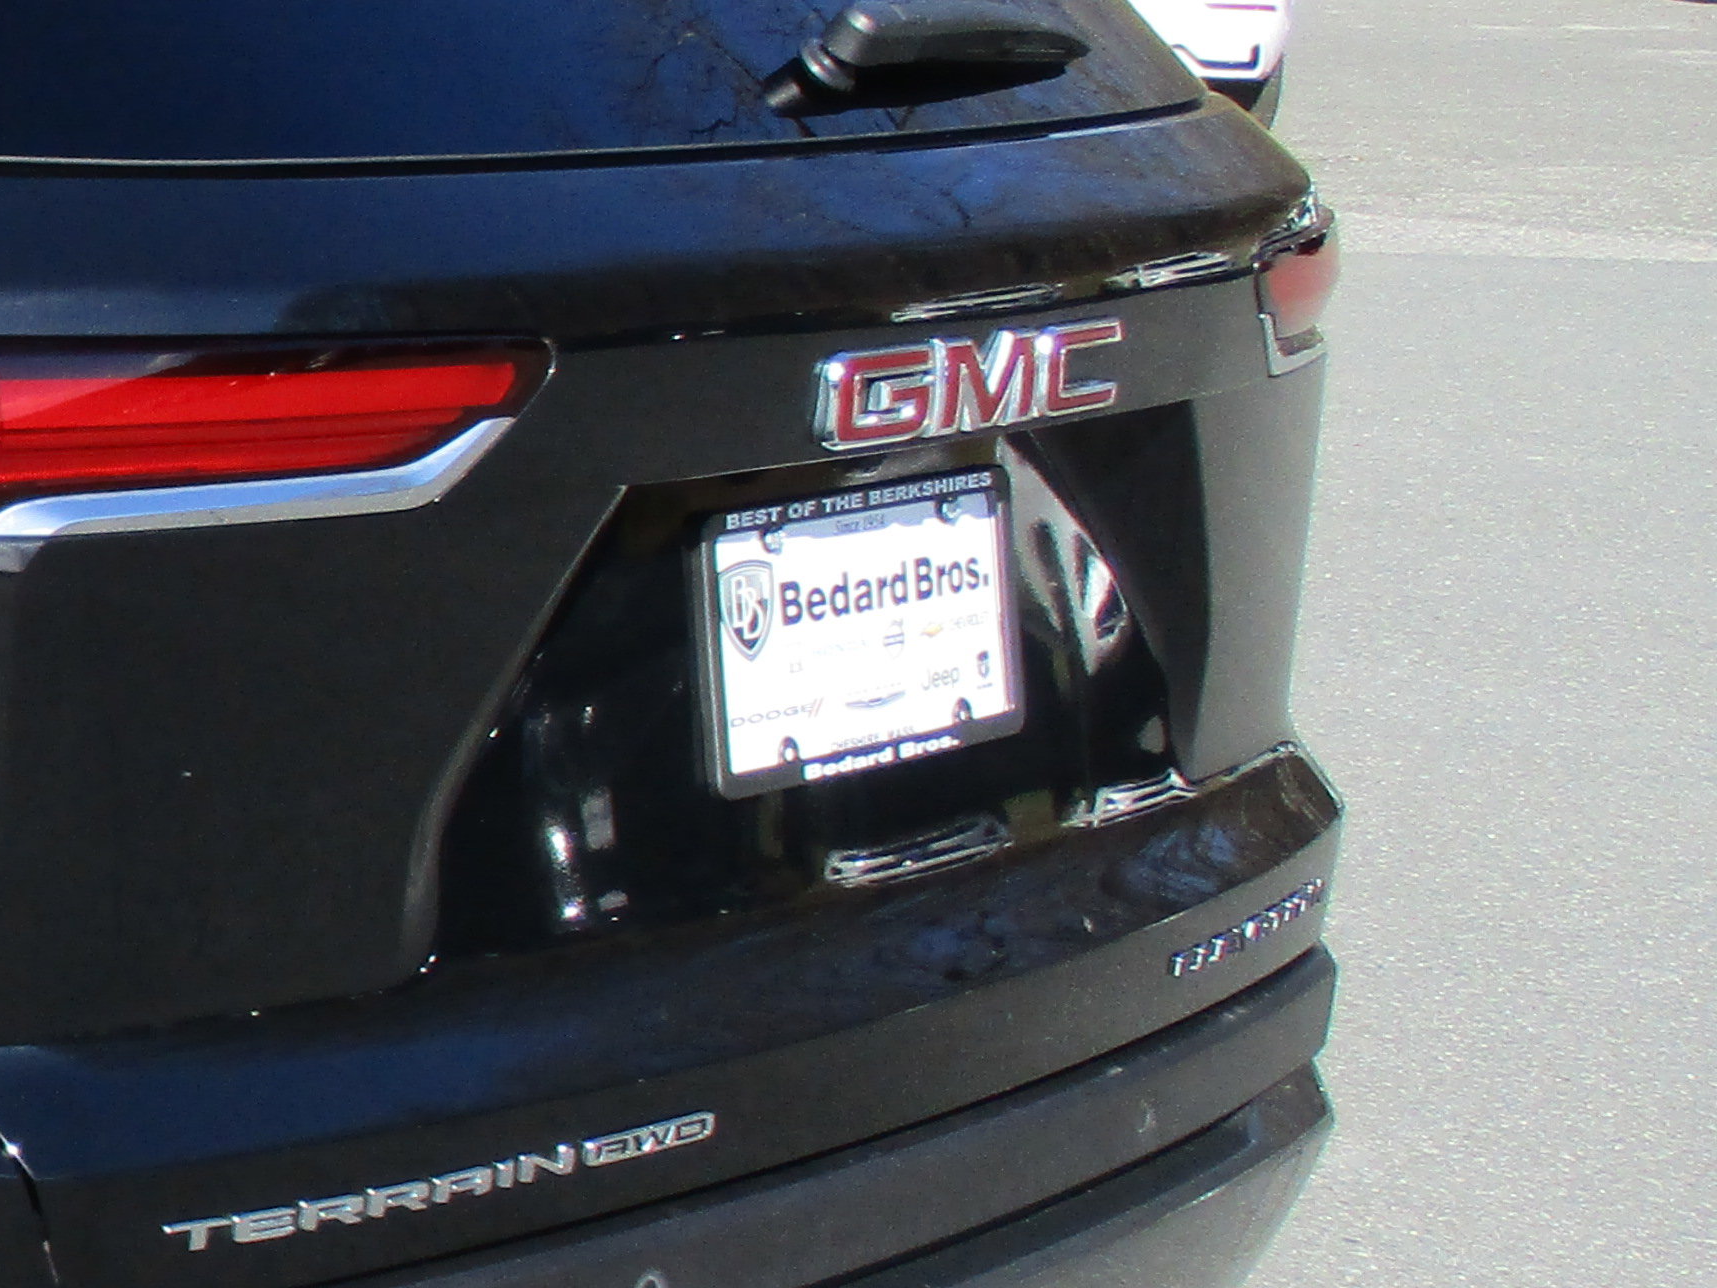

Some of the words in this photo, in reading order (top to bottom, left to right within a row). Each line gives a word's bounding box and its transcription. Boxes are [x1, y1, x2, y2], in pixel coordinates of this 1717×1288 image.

[812, 316, 1126, 451] GMC
[725, 506, 782, 530] BEST
[787, 499, 816, 519] OF
[822, 492, 864, 513] THE
[868, 472, 992, 506] BERKSHIRES
[779, 560, 908, 626] Bedard
[913, 556, 990, 602] Bros.
[921, 665, 961, 692] Jeep
[730, 703, 814, 727] DODGE
[802, 746, 894, 781] Bedard
[896, 733, 961, 759] Bros.
[162, 1143, 576, 1251] TERRAIN
[589, 1112, 714, 1166] AWD
